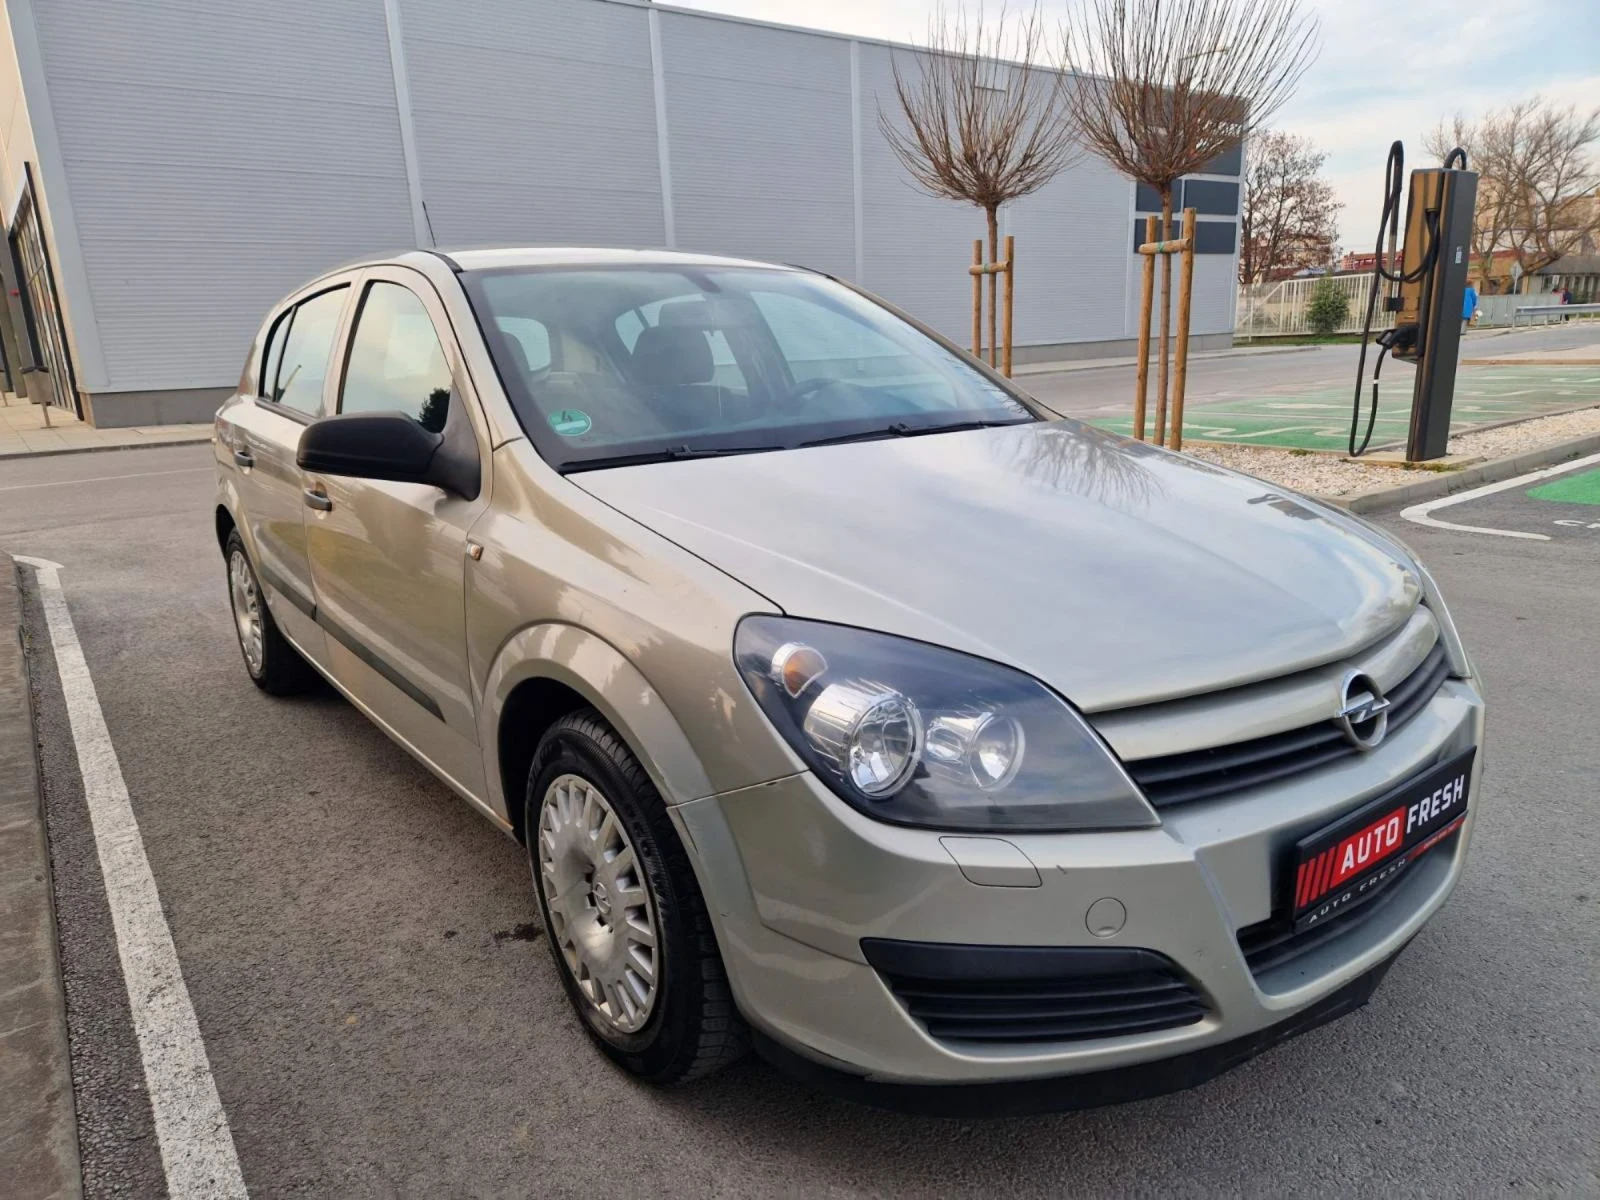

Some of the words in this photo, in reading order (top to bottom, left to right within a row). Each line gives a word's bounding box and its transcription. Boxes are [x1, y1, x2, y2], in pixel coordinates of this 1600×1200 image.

[1340, 816, 1400, 875] AUTO
[1406, 774, 1465, 834] FRESH
[1308, 892, 1352, 924] AUTO
